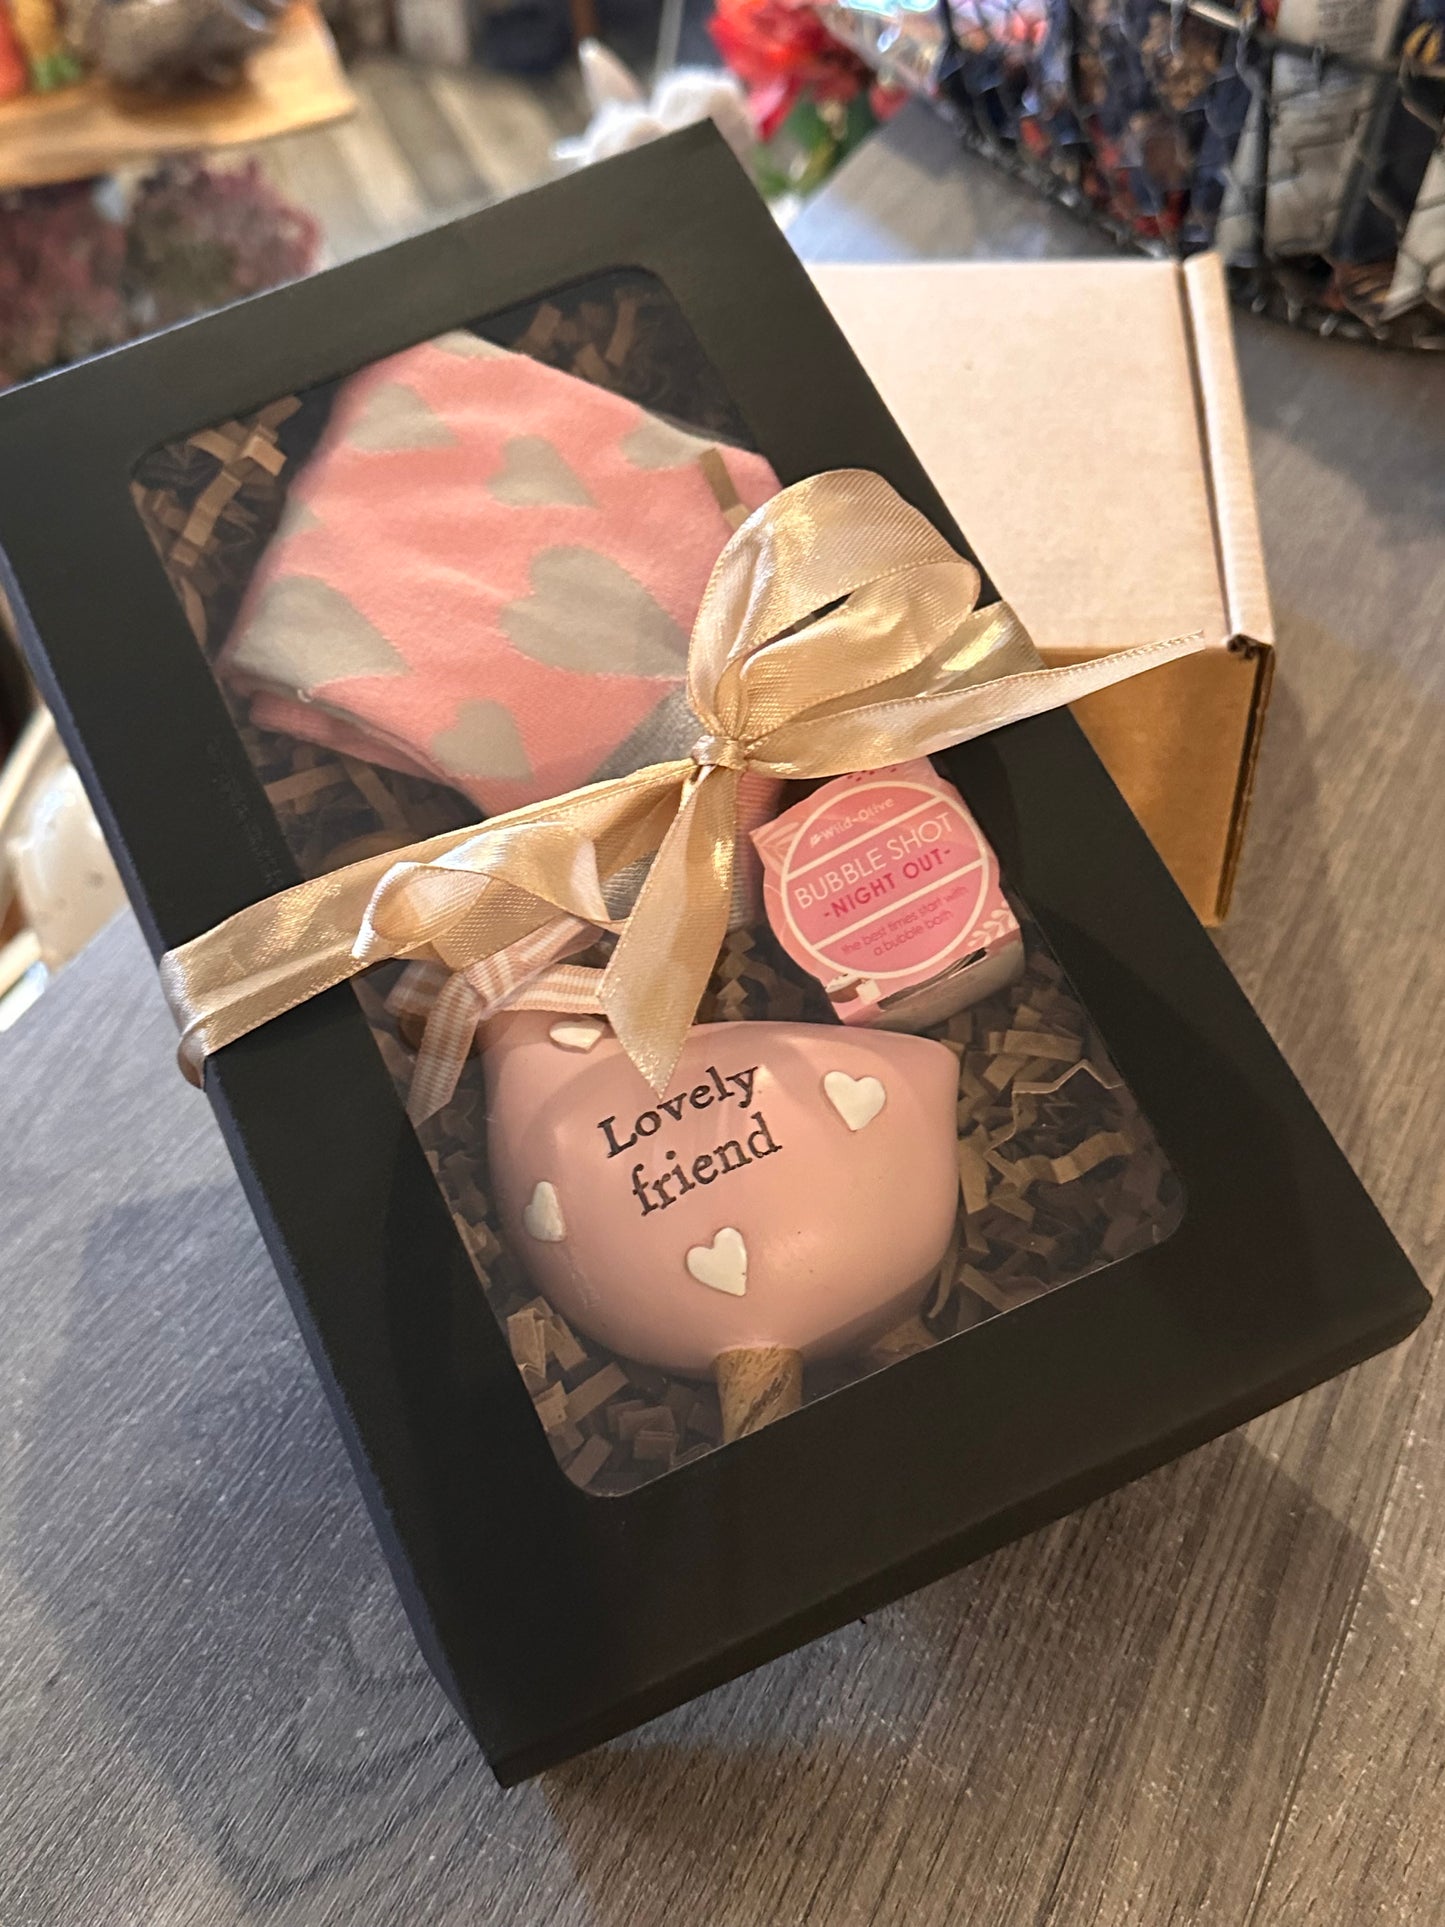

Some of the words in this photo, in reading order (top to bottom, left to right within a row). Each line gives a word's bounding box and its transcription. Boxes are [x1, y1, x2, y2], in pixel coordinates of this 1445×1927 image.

[794, 847, 887, 909] BUBBLE
[887, 812, 954, 860] SHOT
[841, 940, 861, 955] the
[863, 927, 887, 945] best
[888, 913, 918, 932] times
[920, 898, 944, 916] start
[944, 886, 968, 903] with
[873, 945, 884, 957] a
[883, 925, 925, 952] bubble
[925, 908, 954, 929] bath
[597, 1065, 759, 1159] Lovely
[632, 1111, 783, 1217] friend
